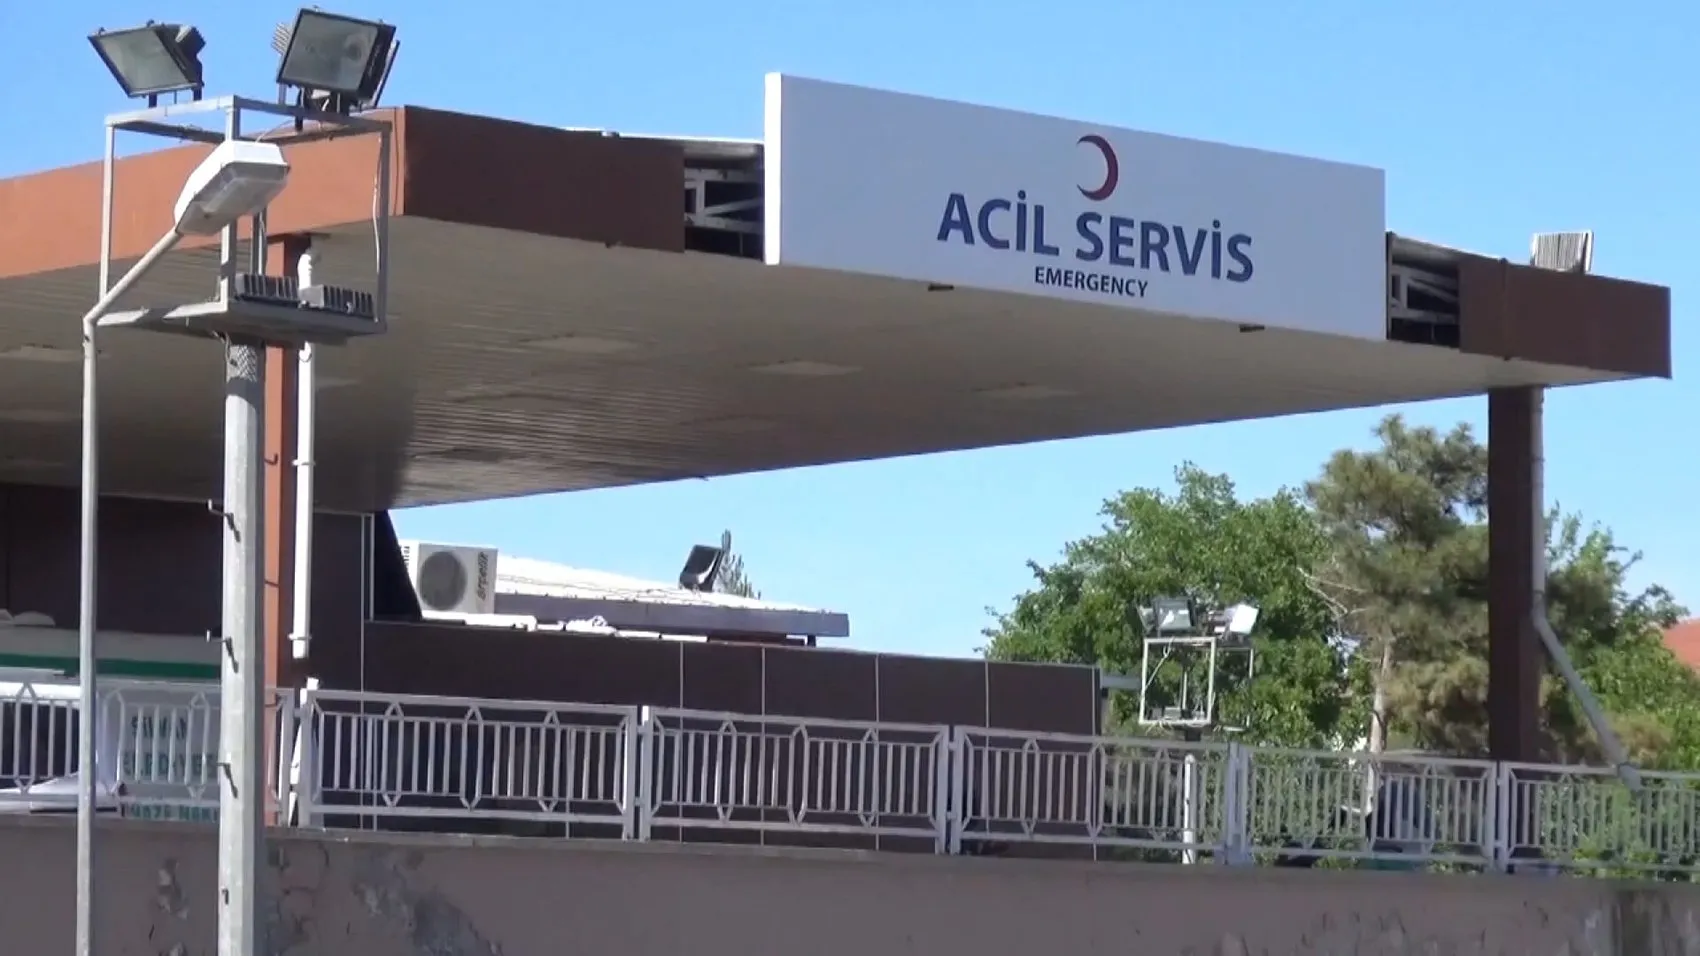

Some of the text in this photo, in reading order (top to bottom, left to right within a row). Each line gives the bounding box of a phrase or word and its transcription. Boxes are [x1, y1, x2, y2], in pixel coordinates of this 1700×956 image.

[937, 189, 1255, 283] ACİL SERVİS
[1034, 265, 1149, 298] EMERGENCY
